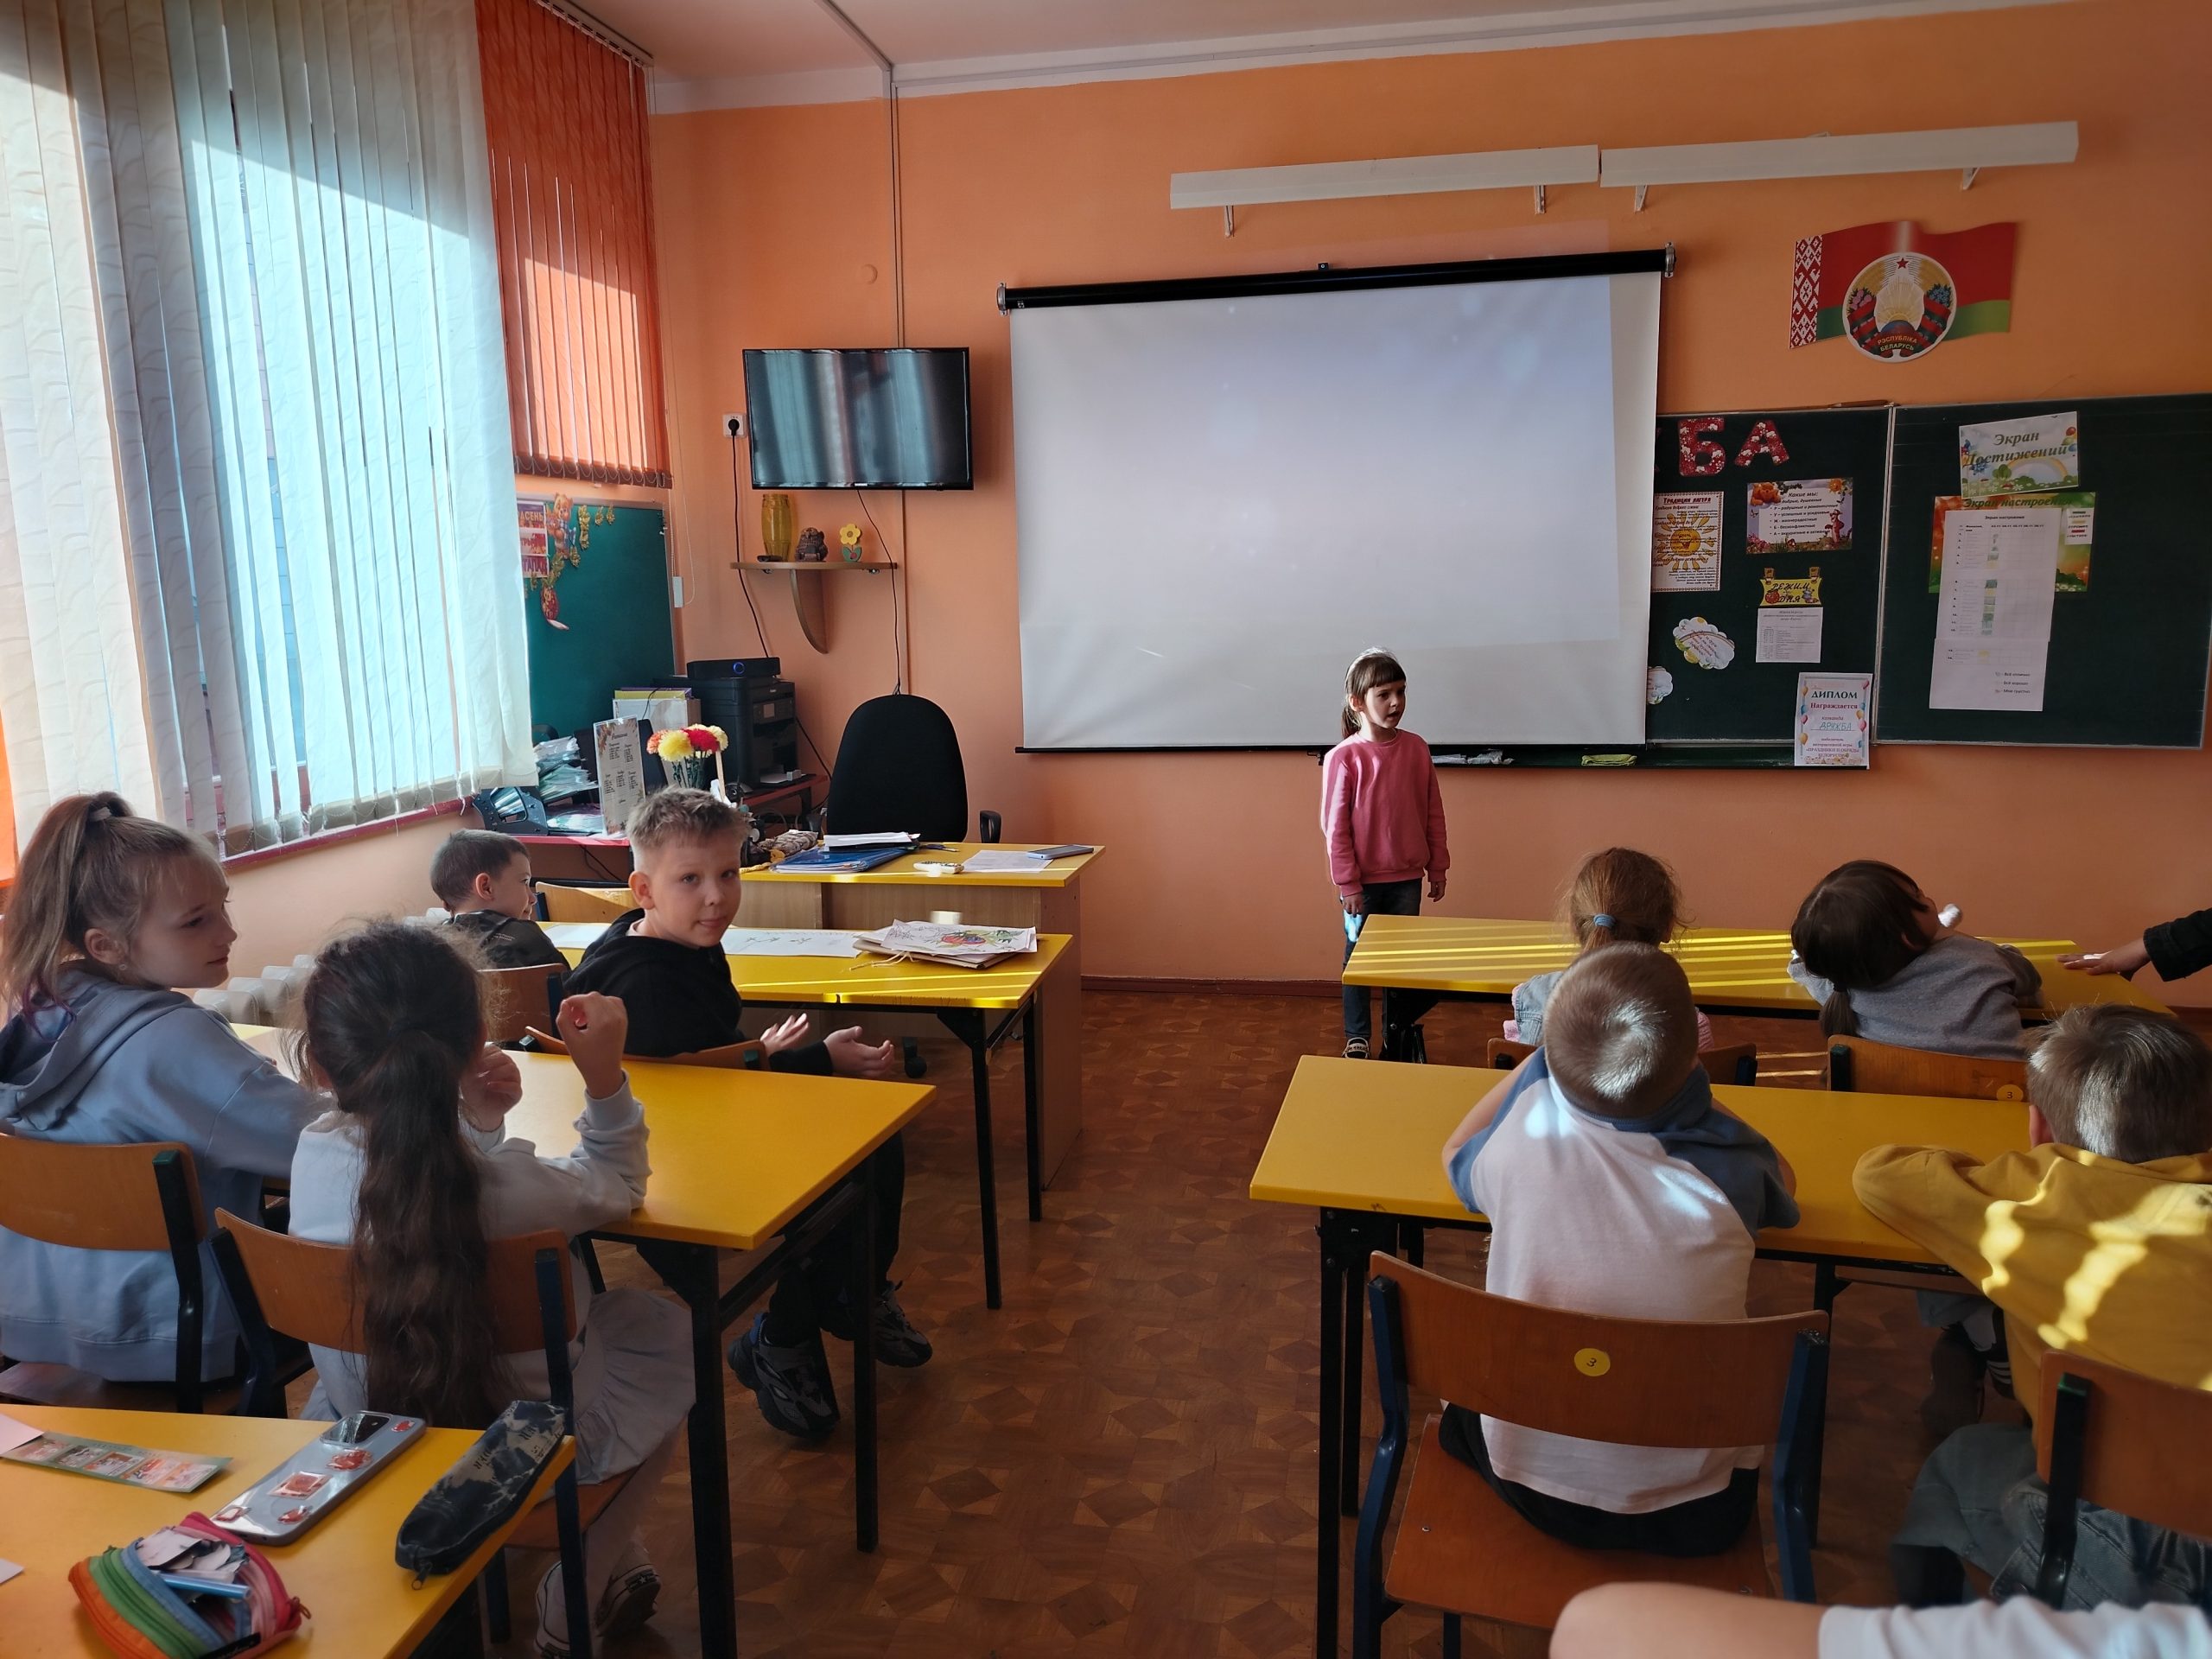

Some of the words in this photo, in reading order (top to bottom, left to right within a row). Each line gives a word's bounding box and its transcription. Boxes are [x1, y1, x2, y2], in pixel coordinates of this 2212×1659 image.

[1877, 335, 1917, 346] РЭСПУБЛІКА
[1879, 342, 1915, 352] БЕЛАРУСЬ
[1993, 432, 2039, 446] Экран
[1656, 416, 1789, 477] БА
[1965, 445, 2069, 466] Достижений
[1962, 498, 1998, 508] Экран
[518, 511, 543, 522] АСЕНЬ
[1819, 721, 1852, 732] ДРУЖБА
[1586, 1357, 1597, 1367] 3
